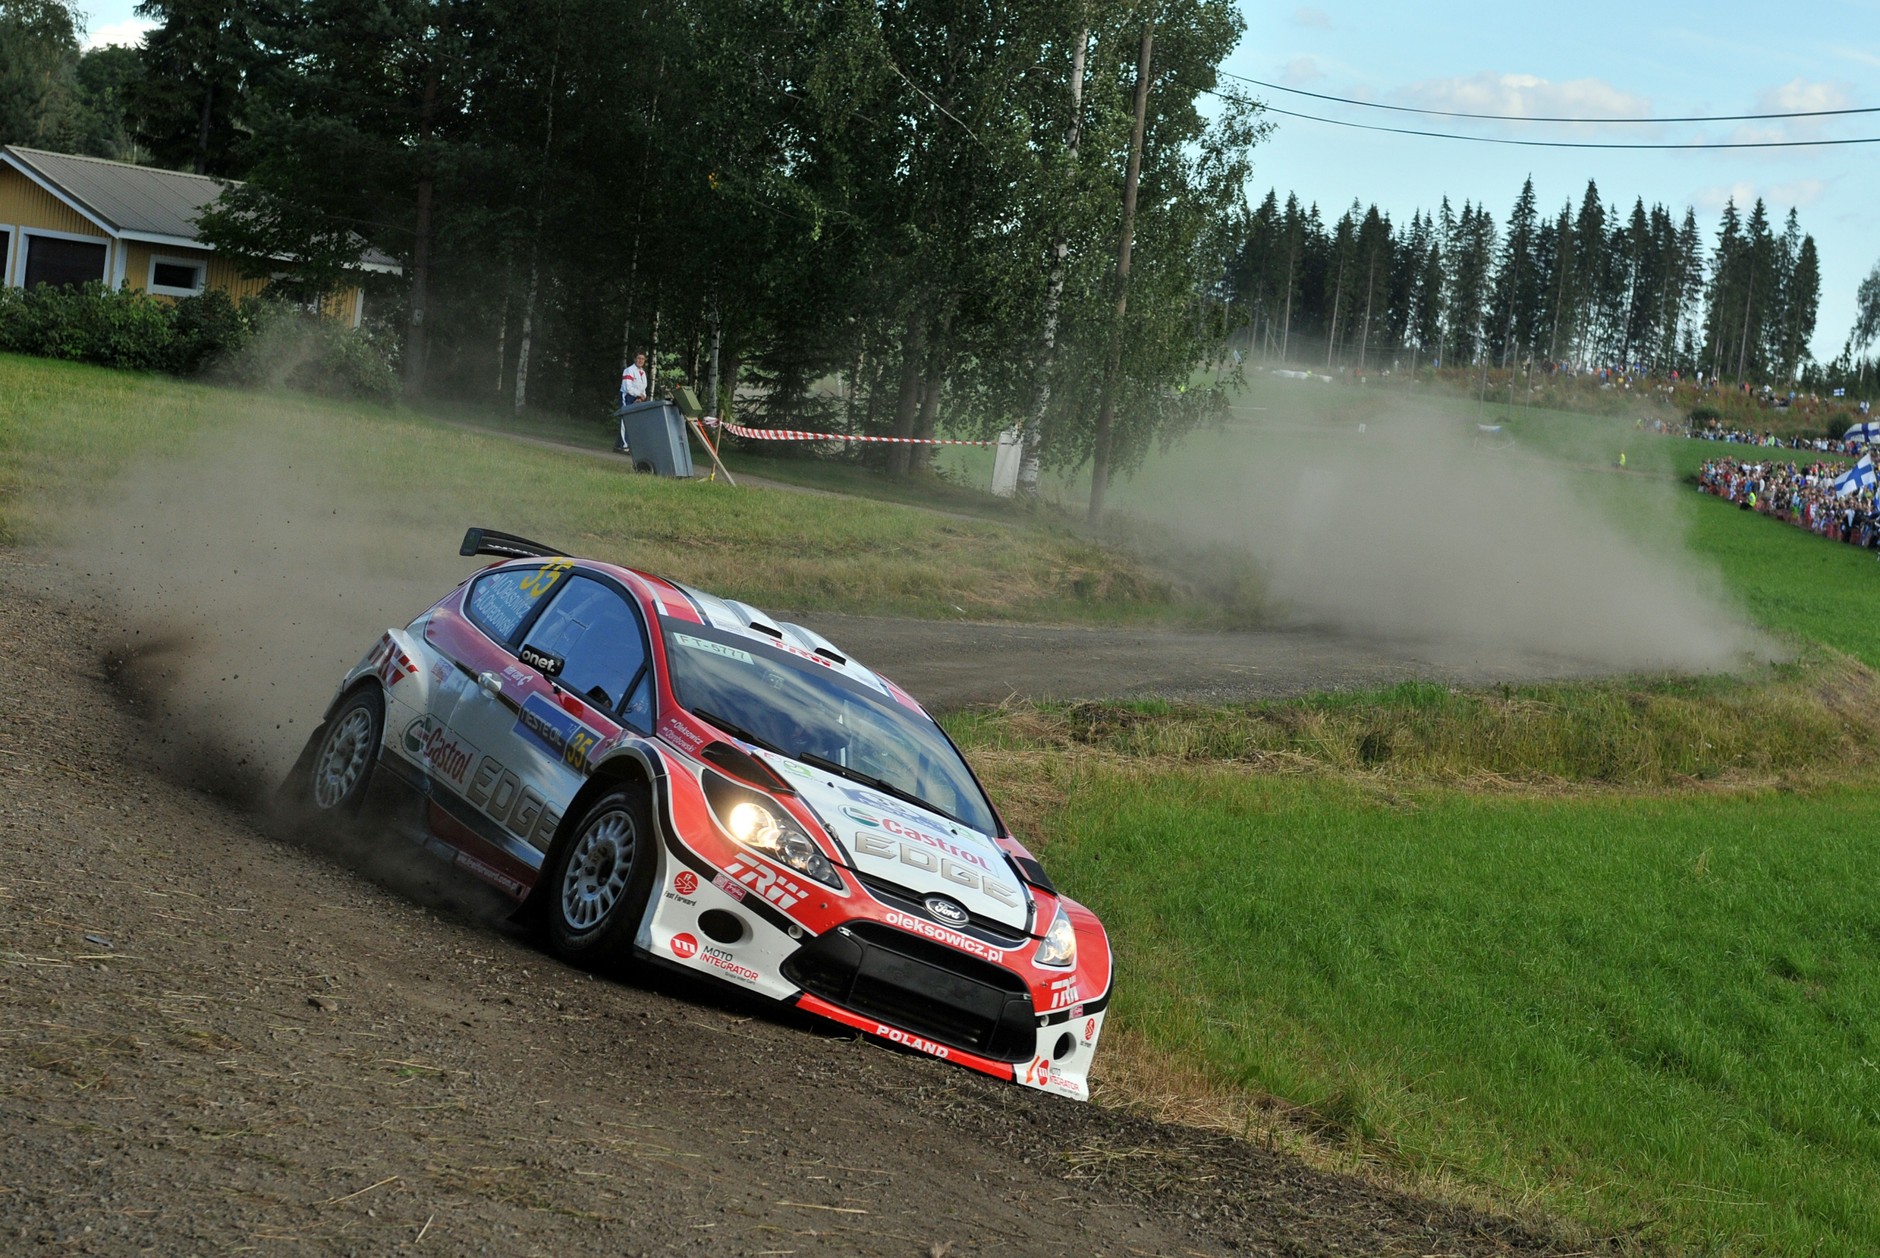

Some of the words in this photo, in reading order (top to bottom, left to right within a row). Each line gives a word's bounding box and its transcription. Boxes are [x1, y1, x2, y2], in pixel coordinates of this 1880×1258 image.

[519, 556, 574, 598] 35
[519, 704, 549, 737] NESTE
[423, 727, 475, 785] Castrol
[566, 732, 593, 769] 35
[465, 755, 558, 852] EDGE
[882, 816, 992, 872] Castrol
[723, 852, 810, 911] TRW
[854, 831, 1020, 909] EDGE
[934, 901, 961, 920] Ford
[703, 945, 734, 962] MOTO
[886, 912, 1004, 964] oleksowicz.pl
[699, 954, 759, 981] INTEGRATOR
[876, 1024, 950, 1059] POLAND
